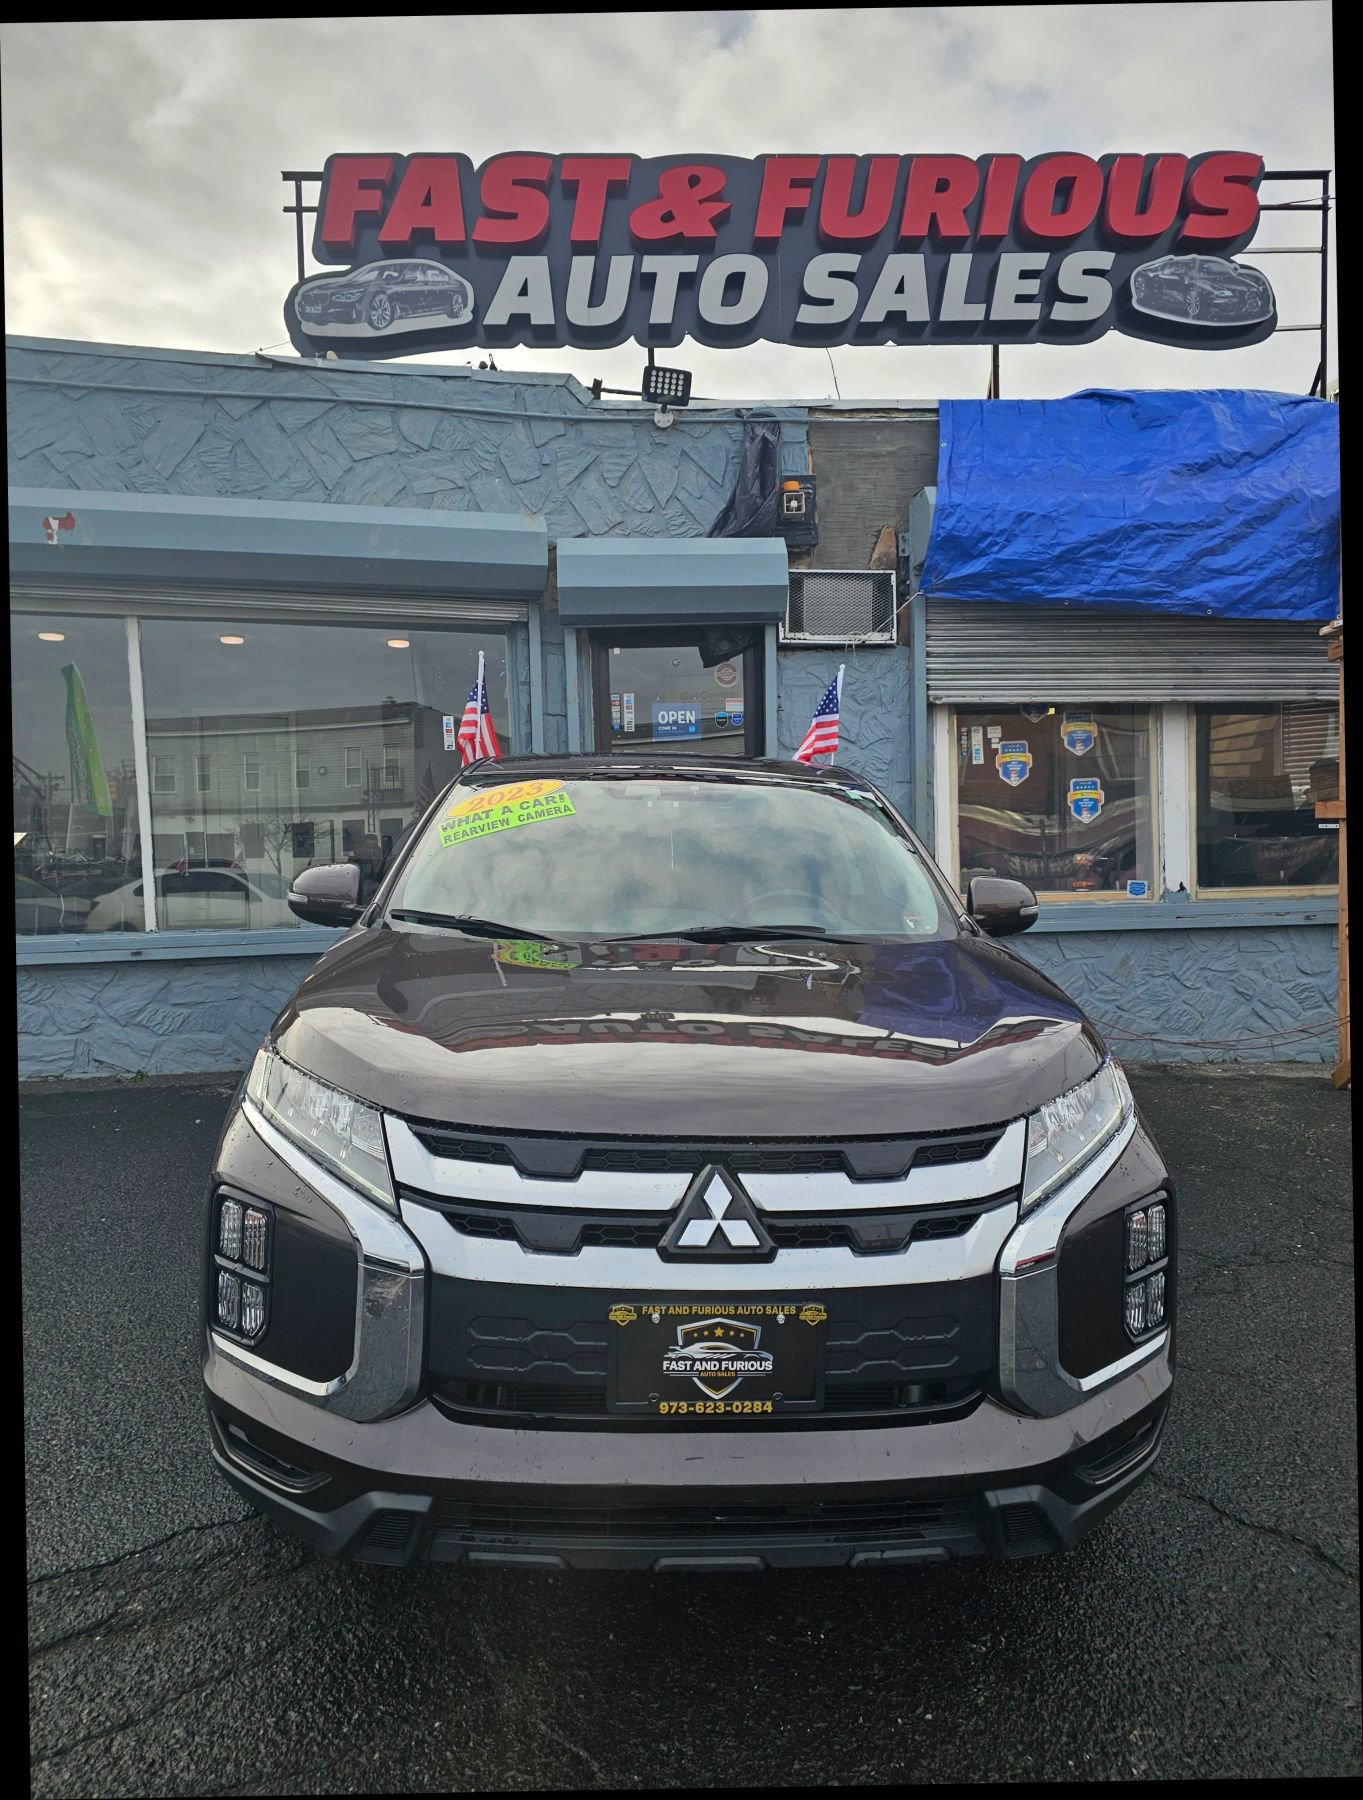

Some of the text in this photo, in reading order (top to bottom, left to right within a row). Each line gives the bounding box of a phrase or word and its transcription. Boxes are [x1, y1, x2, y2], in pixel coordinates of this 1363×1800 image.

[320, 151, 1264, 247] FAST & FURIOUS
[482, 251, 1116, 328] AUTO SALES
[658, 711, 696, 724] OPEN
[466, 782, 545, 812] 2023
[440, 793, 566, 833] WHAT A CAR!
[443, 804, 573, 844] REARVIEW CAMERA
[642, 1306, 796, 1315] FAST AND FURIOUS AUTO SALES
[662, 1360, 773, 1371] FAST AND FURIOUS
[659, 1401, 773, 1414] 973-623-0284
